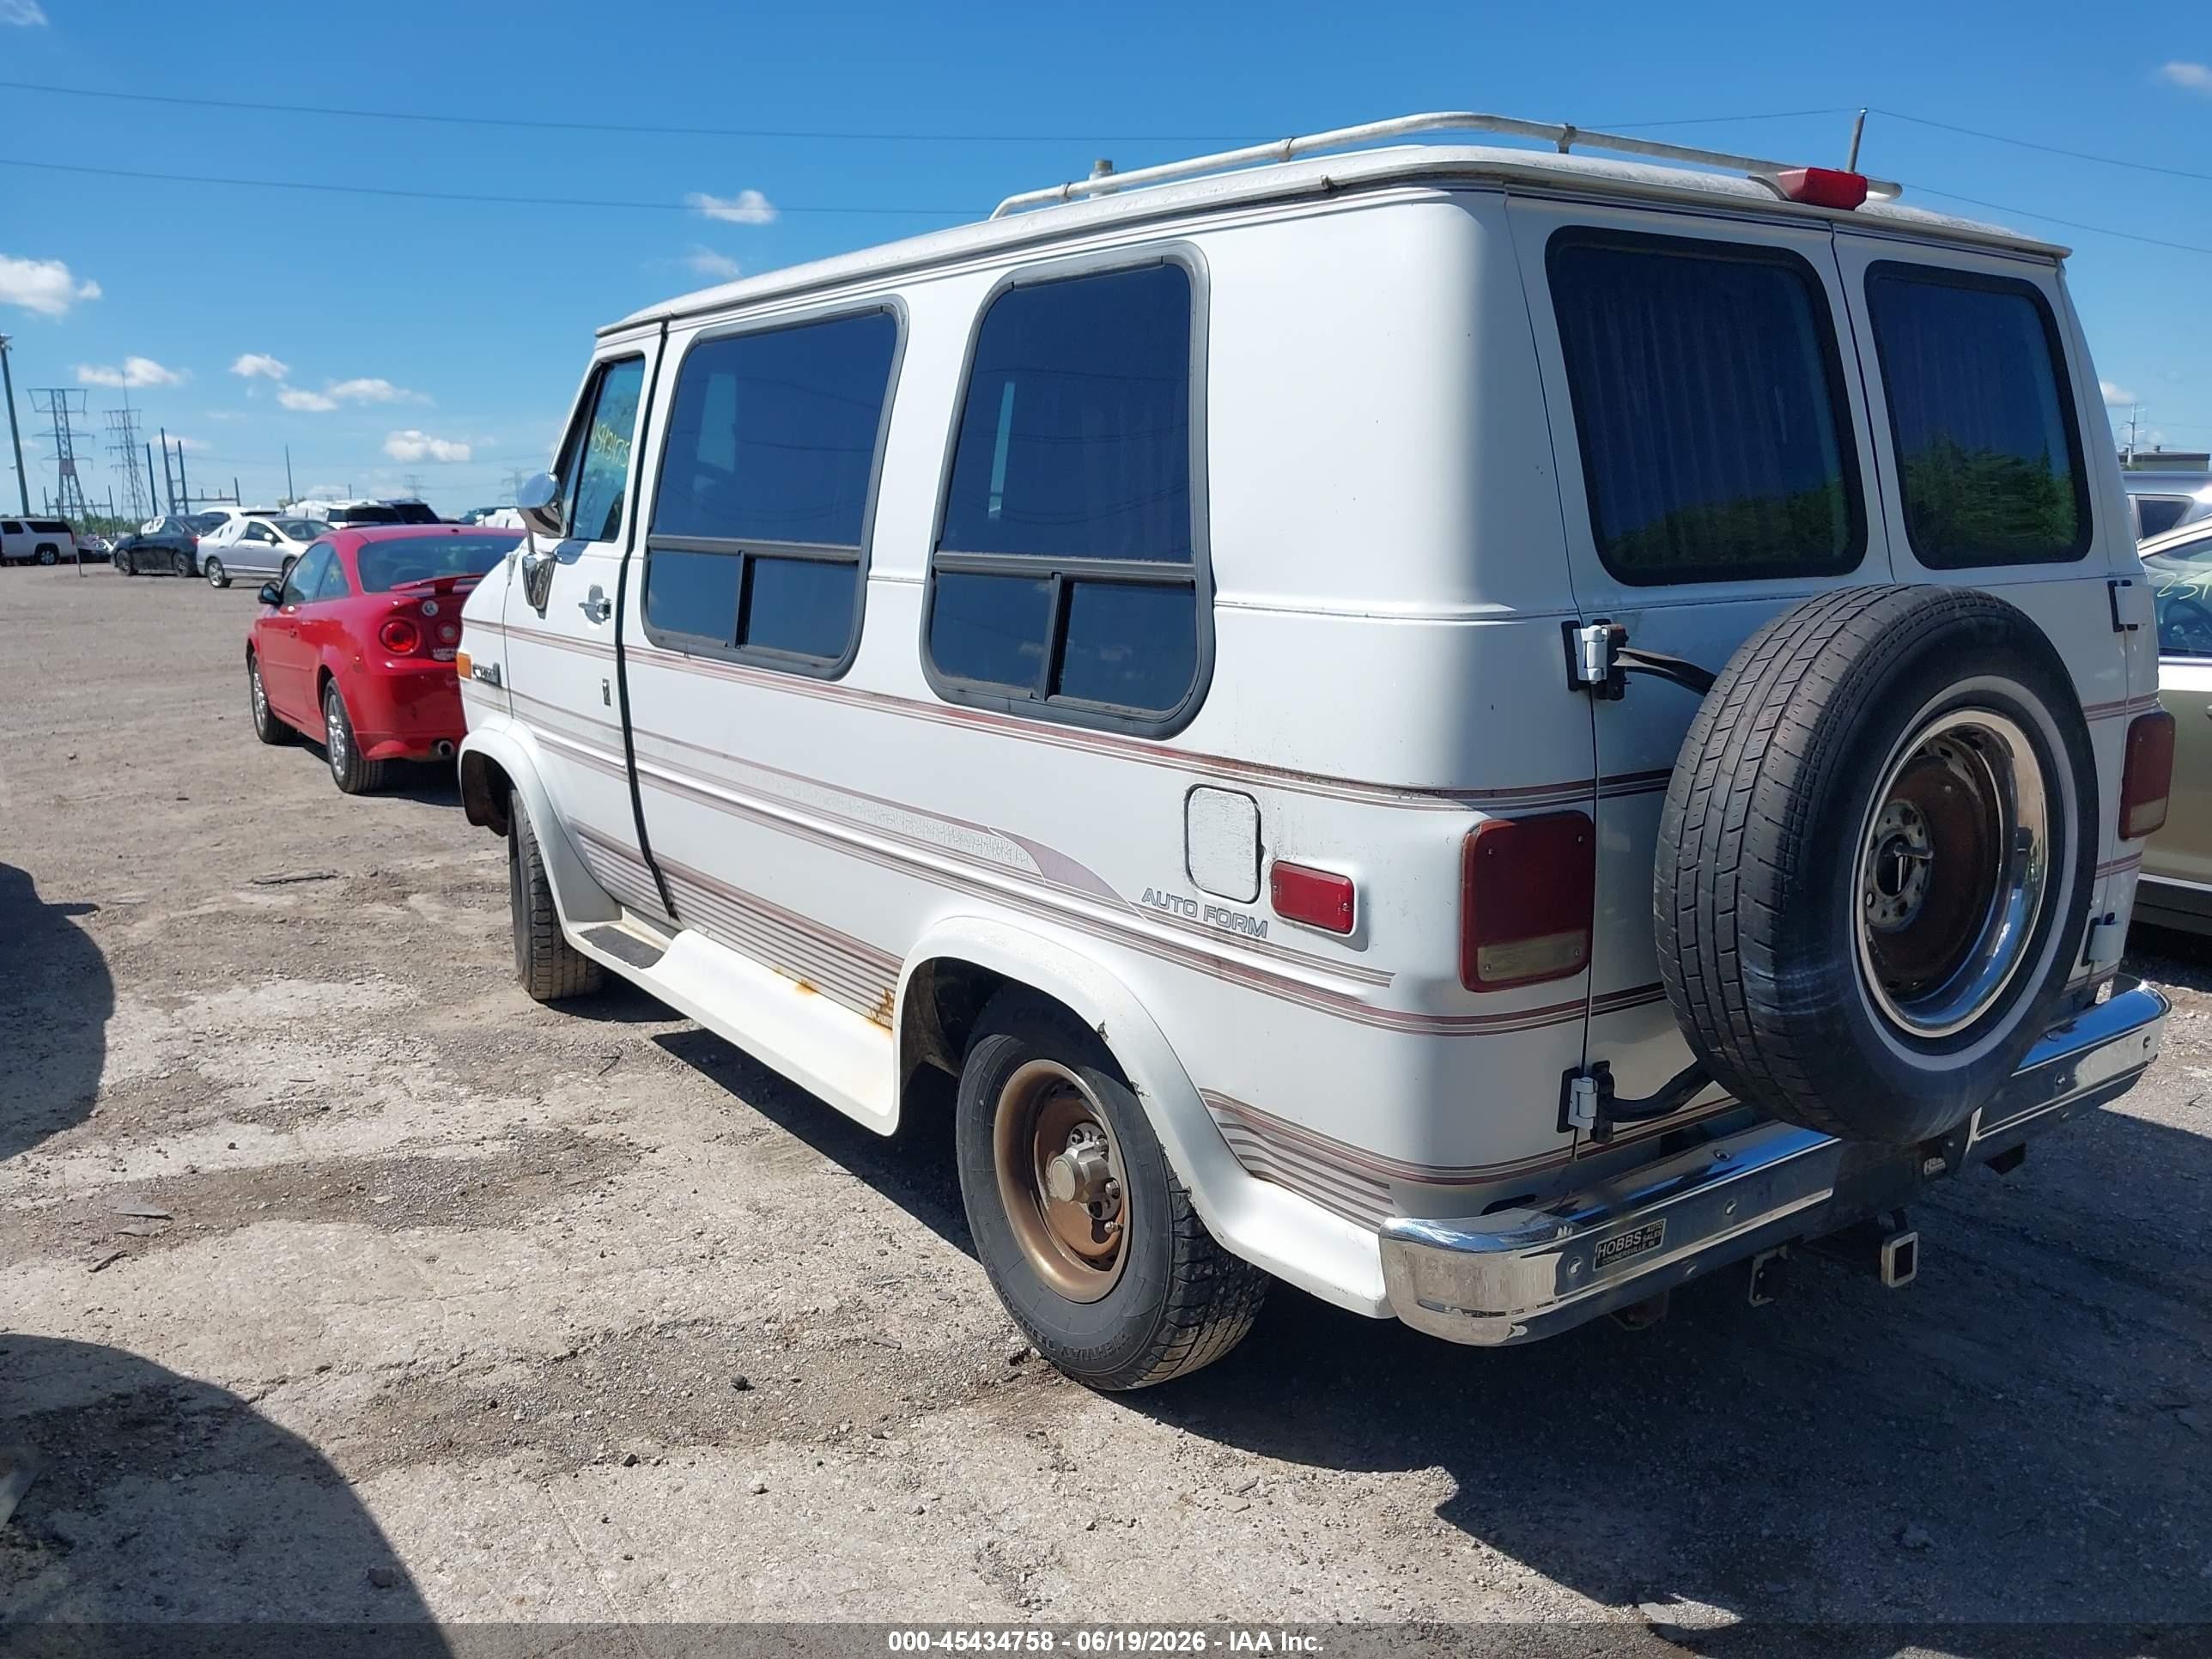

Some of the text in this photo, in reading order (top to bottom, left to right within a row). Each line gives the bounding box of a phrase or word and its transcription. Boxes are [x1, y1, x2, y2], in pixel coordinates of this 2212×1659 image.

[1141, 886, 1269, 939] AUTO FORM
[1642, 1229, 1662, 1243] SALES
[1646, 1221, 1663, 1234] AUTO
[1597, 1231, 1642, 1260] HOBBS
